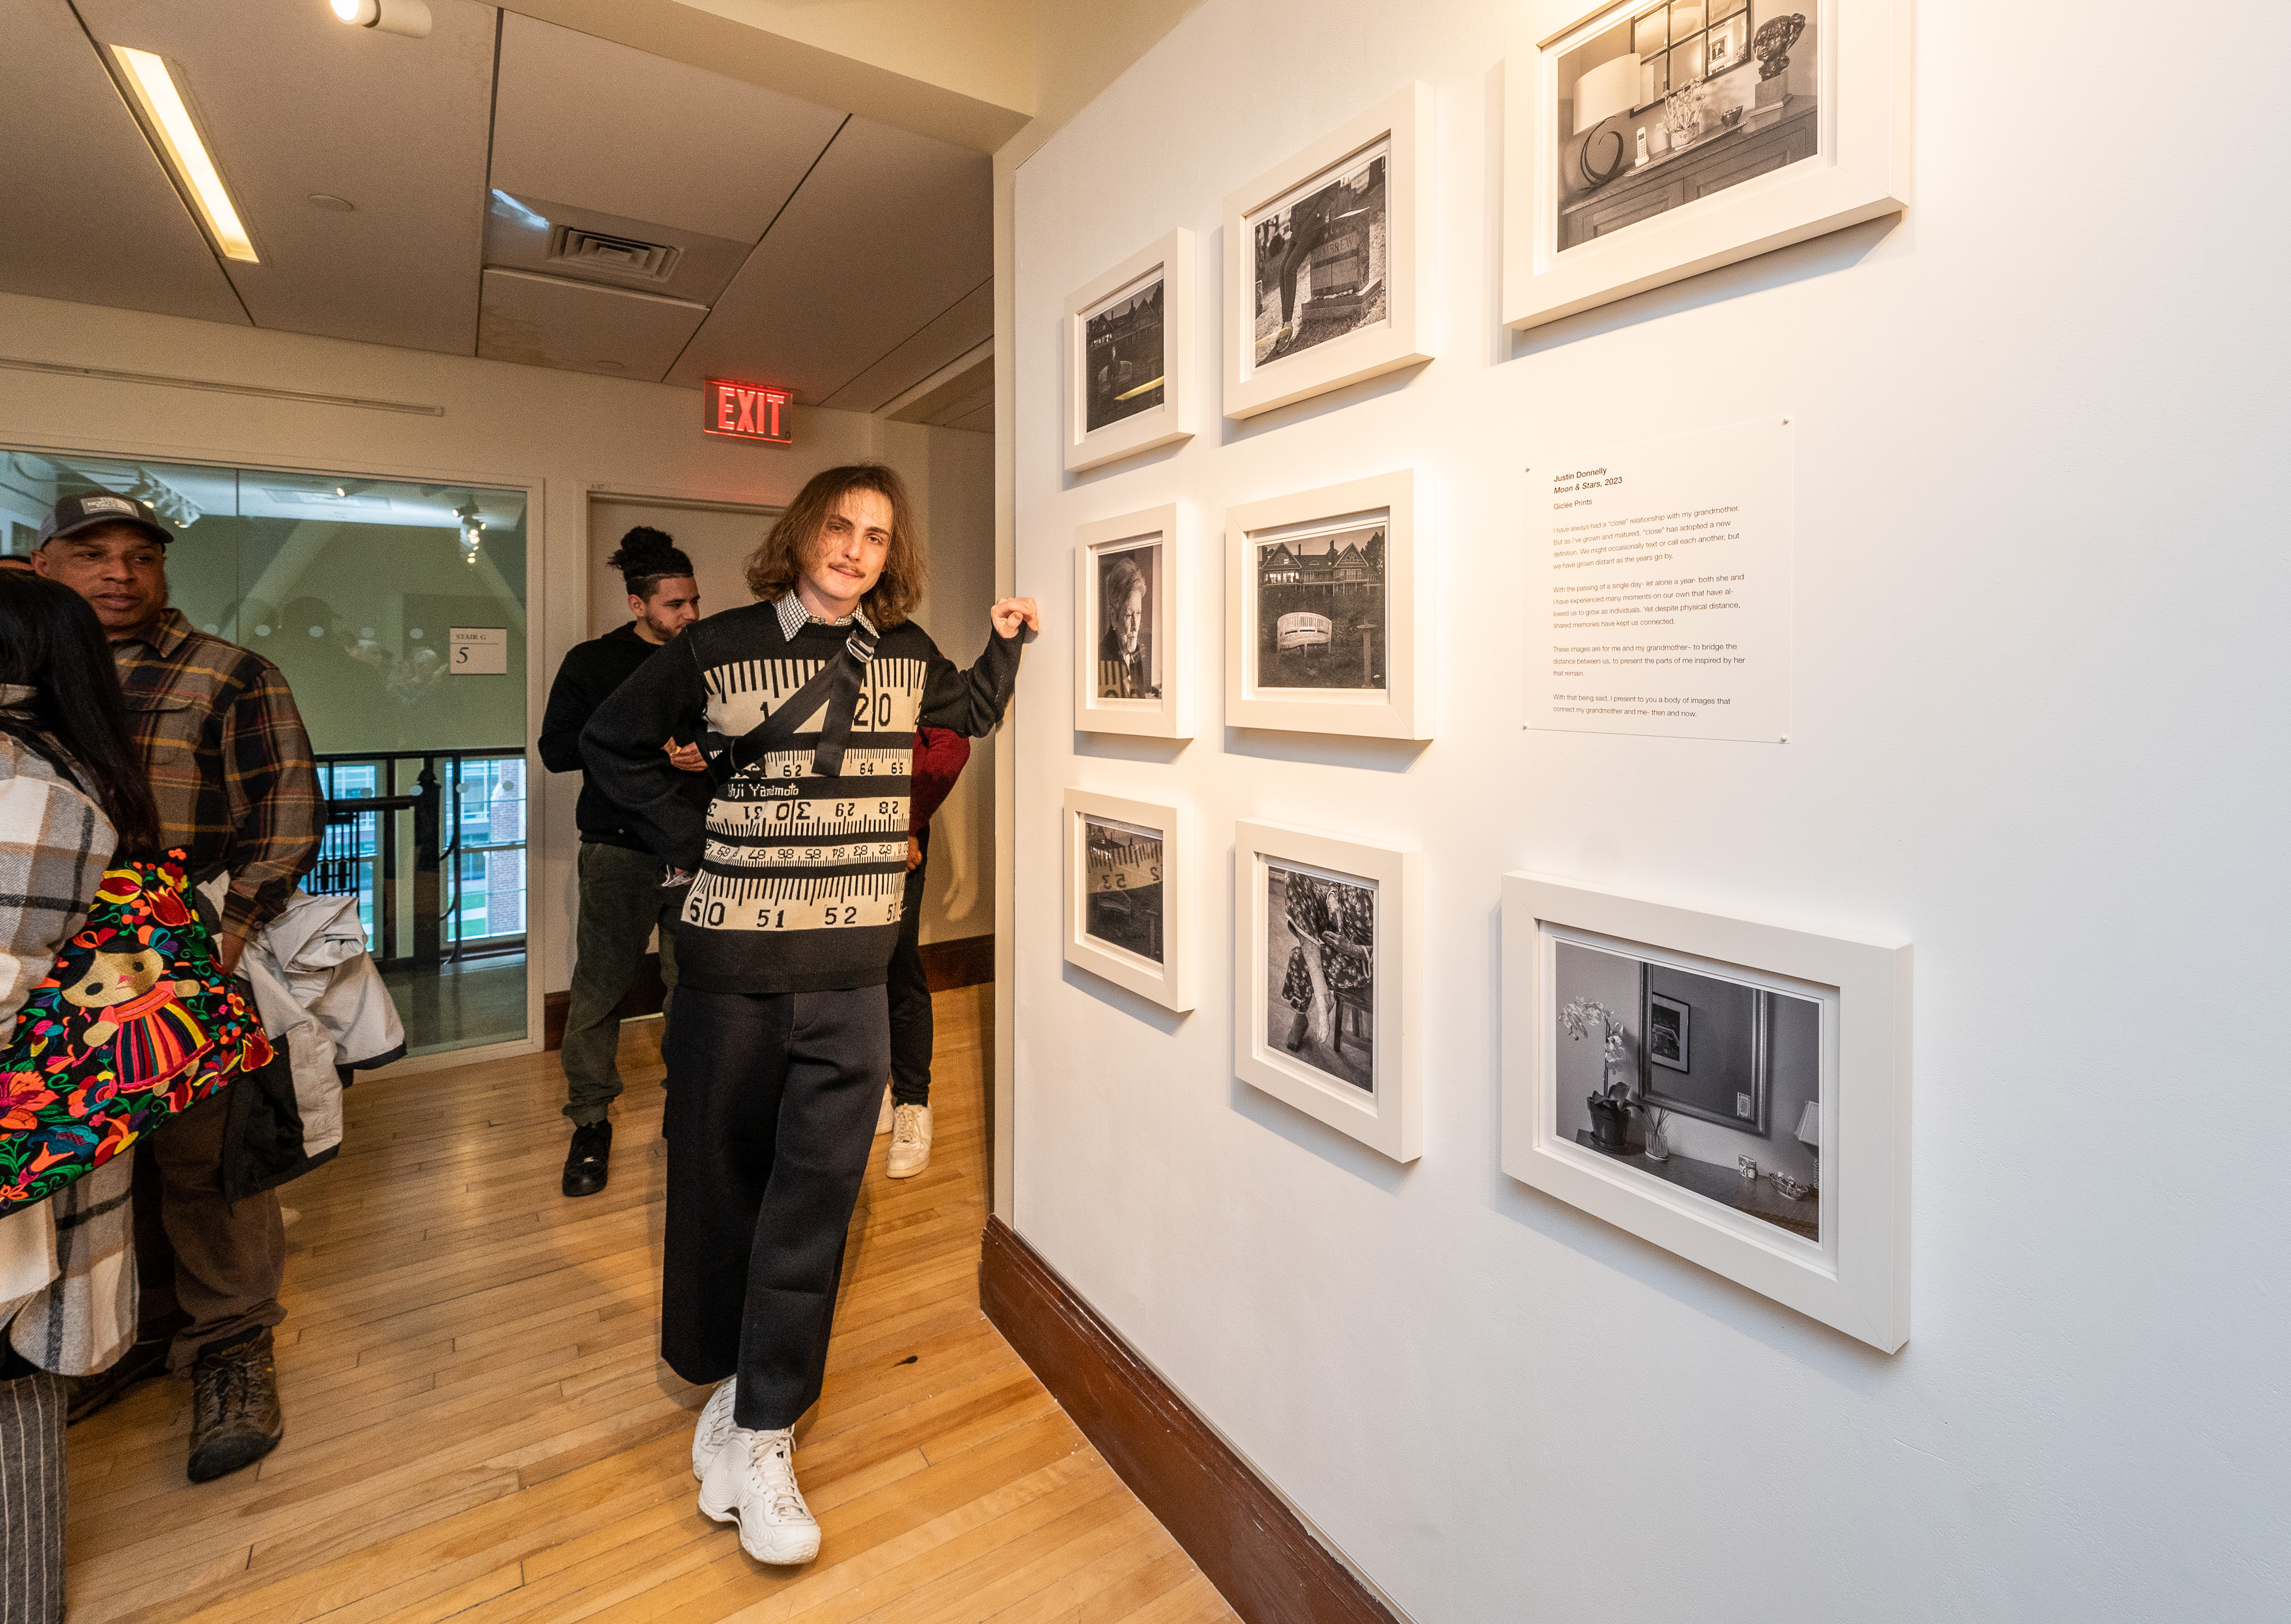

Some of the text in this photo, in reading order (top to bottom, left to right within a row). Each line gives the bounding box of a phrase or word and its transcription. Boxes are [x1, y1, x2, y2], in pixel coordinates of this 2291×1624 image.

[718, 387, 785, 436] EXIT
[1554, 467, 1607, 482] Justin Donnelly
[1553, 486, 1573, 494] Moon
[1582, 482, 1602, 490] Stars,
[1604, 476, 1623, 486] 2023
[1553, 501, 1573, 510] Giclée
[1630, 514, 1665, 524] relationship
[1694, 506, 1739, 518] grandmother.
[1583, 535, 1600, 544] grown
[1614, 530, 1641, 538] matured,
[1679, 522, 1708, 531] adopted
[1591, 546, 1607, 554] might
[1608, 542, 1644, 552] occasionally
[1680, 537, 1696, 545] each
[1698, 534, 1726, 543] another,
[1577, 561, 1594, 569] grown
[1664, 553, 1674, 561] by.
[1576, 585, 1598, 593] passing
[1612, 582, 1629, 590] single
[1730, 573, 1745, 581] and
[1570, 596, 1604, 605] experienced
[1655, 605, 1679, 613] despite
[1680, 603, 1707, 612] physical
[1702, 643, 1724, 652] bridge
[456, 647, 469, 664] 5
[1694, 657, 1721, 665] inspired
[1723, 657, 1732, 665] by
[1578, 695, 1594, 703] being
[1664, 696, 1681, 705] body
[1691, 697, 1715, 705] images
[783, 764, 802, 777] 62
[860, 762, 873, 775] 64
[891, 762, 903, 774] 65
[835, 802, 855, 817] 29
[879, 801, 898, 814] 28
[748, 849, 766, 859] 87
[778, 849, 794, 859] 86
[805, 849, 821, 859] 85
[690, 897, 857, 928] 50 51 52
